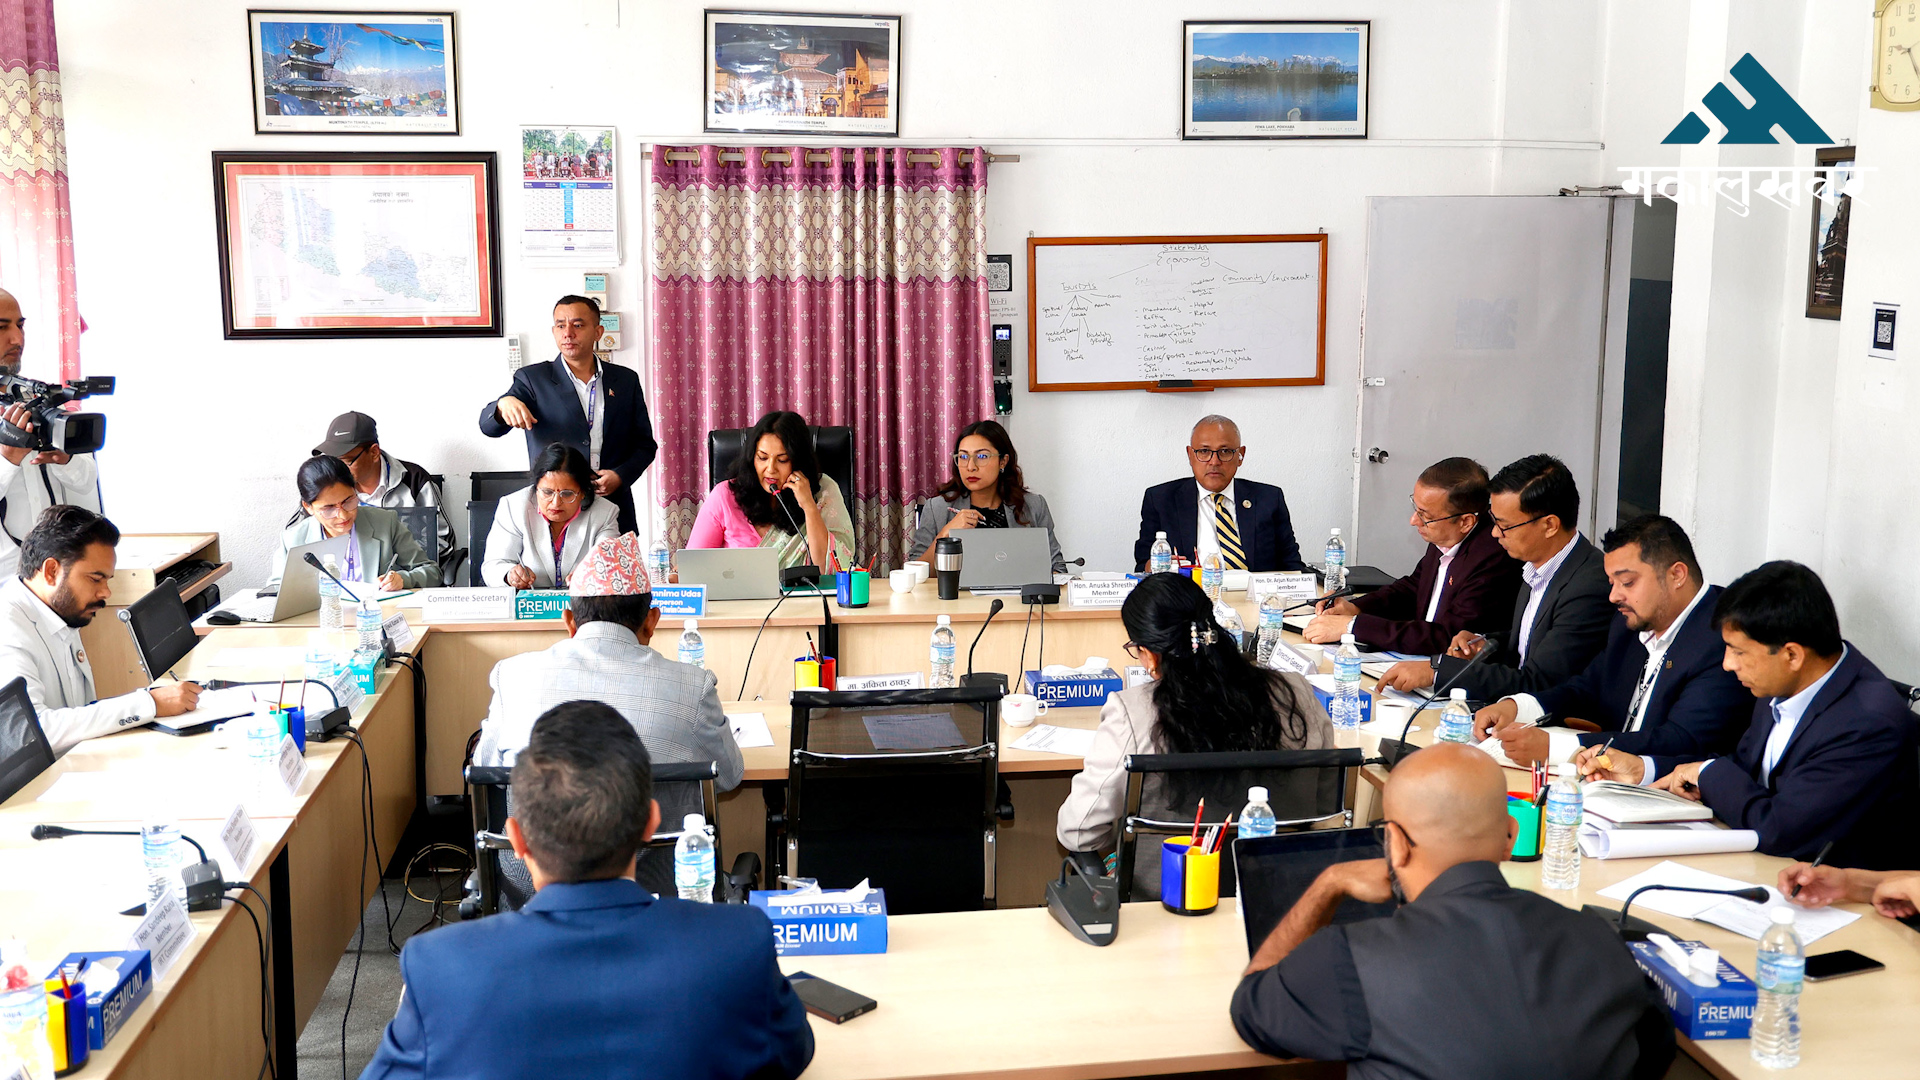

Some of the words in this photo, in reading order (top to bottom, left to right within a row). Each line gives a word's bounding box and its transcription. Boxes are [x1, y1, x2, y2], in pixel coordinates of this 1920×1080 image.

[1895, 5, 1902, 17] 11
[1908, 3, 1916, 15] 12
[1889, 26, 1896, 37] 10
[1888, 46, 1894, 57] 9
[1887, 64, 1893, 75] 8
[1893, 84, 1898, 95] 7
[1905, 84, 1911, 96] 6
[427, 594, 470, 603] Committee
[471, 594, 508, 603] Secretary
[651, 589, 680, 598] mnima
[680, 590, 702, 598] Udas
[651, 598, 684, 606] airperson
[1276, 648, 1290, 662] Director
[1290, 657, 1305, 672] General
[889, 679, 911, 687] ठाकुर
[1037, 683, 1104, 700] PREMIUM
[139, 930, 149, 942] Hon.
[148, 910, 166, 932] Sandeep
[155, 923, 173, 944] Member
[773, 922, 857, 943] REMIUM
[158, 954, 166, 966] IRT
[165, 931, 186, 958] Committee
[103, 969, 143, 1031] PREMIUM
[1698, 1006, 1755, 1020] PREMIU
